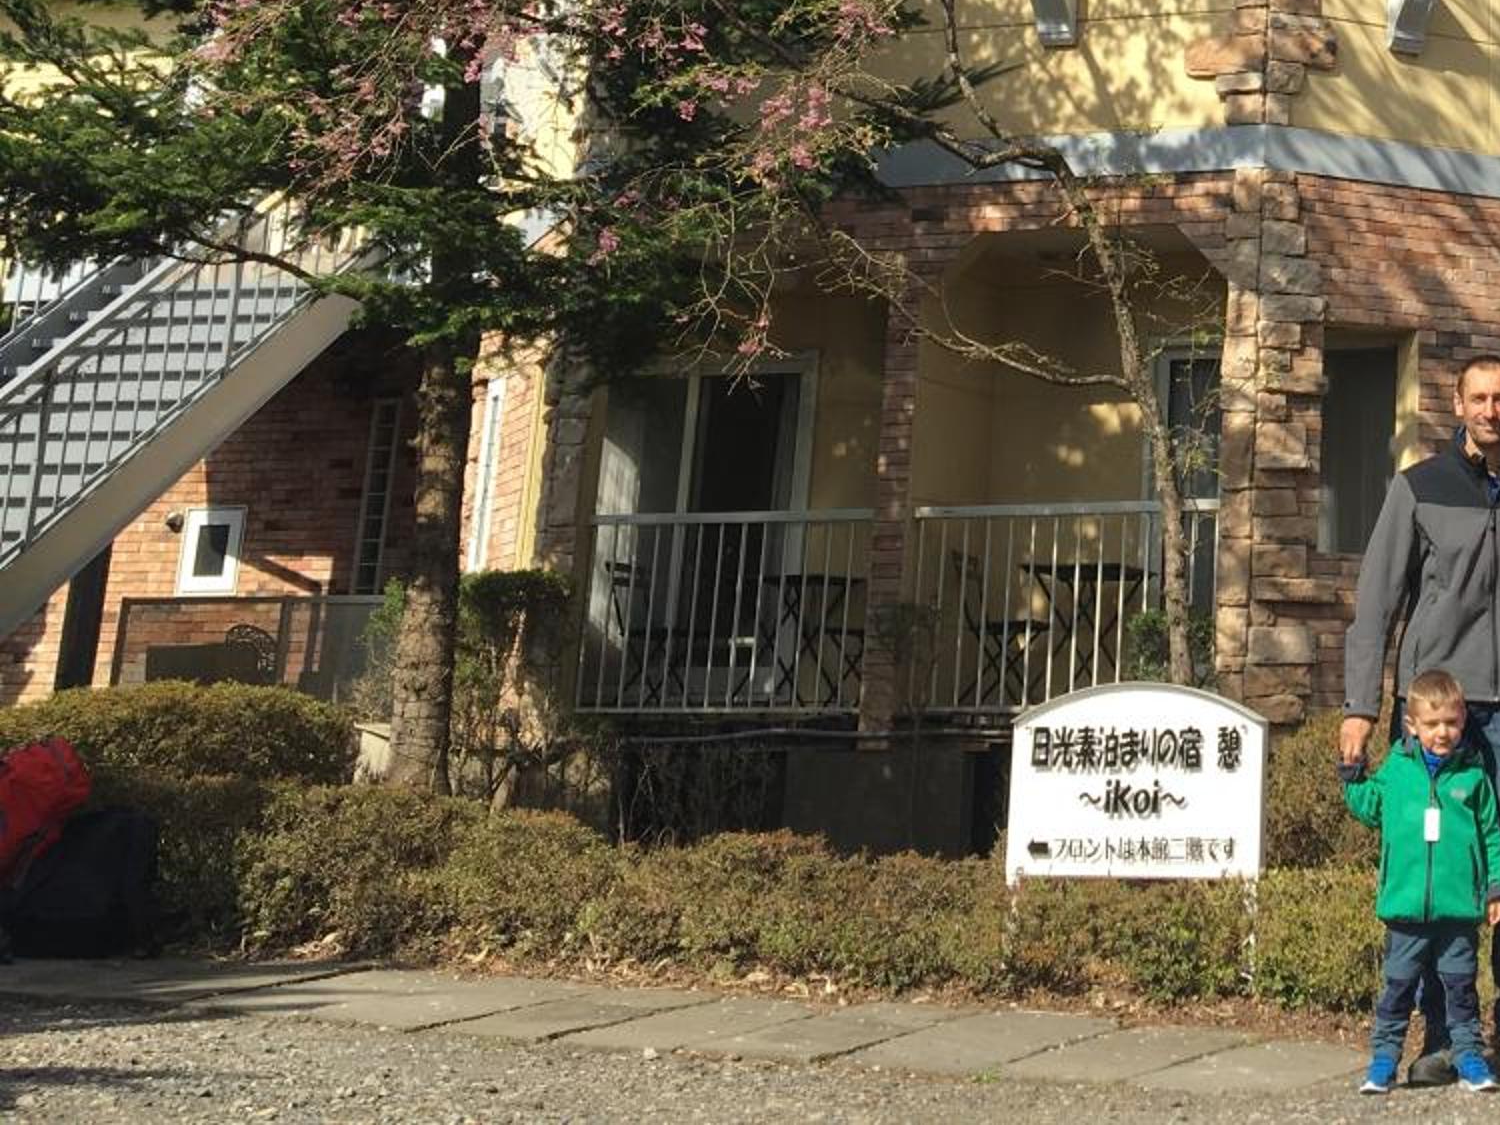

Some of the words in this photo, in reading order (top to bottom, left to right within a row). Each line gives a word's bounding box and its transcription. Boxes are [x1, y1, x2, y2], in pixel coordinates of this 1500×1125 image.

[1031, 725, 1201, 769] 日光素泊まりの宿
[1217, 725, 1241, 770] 憩
